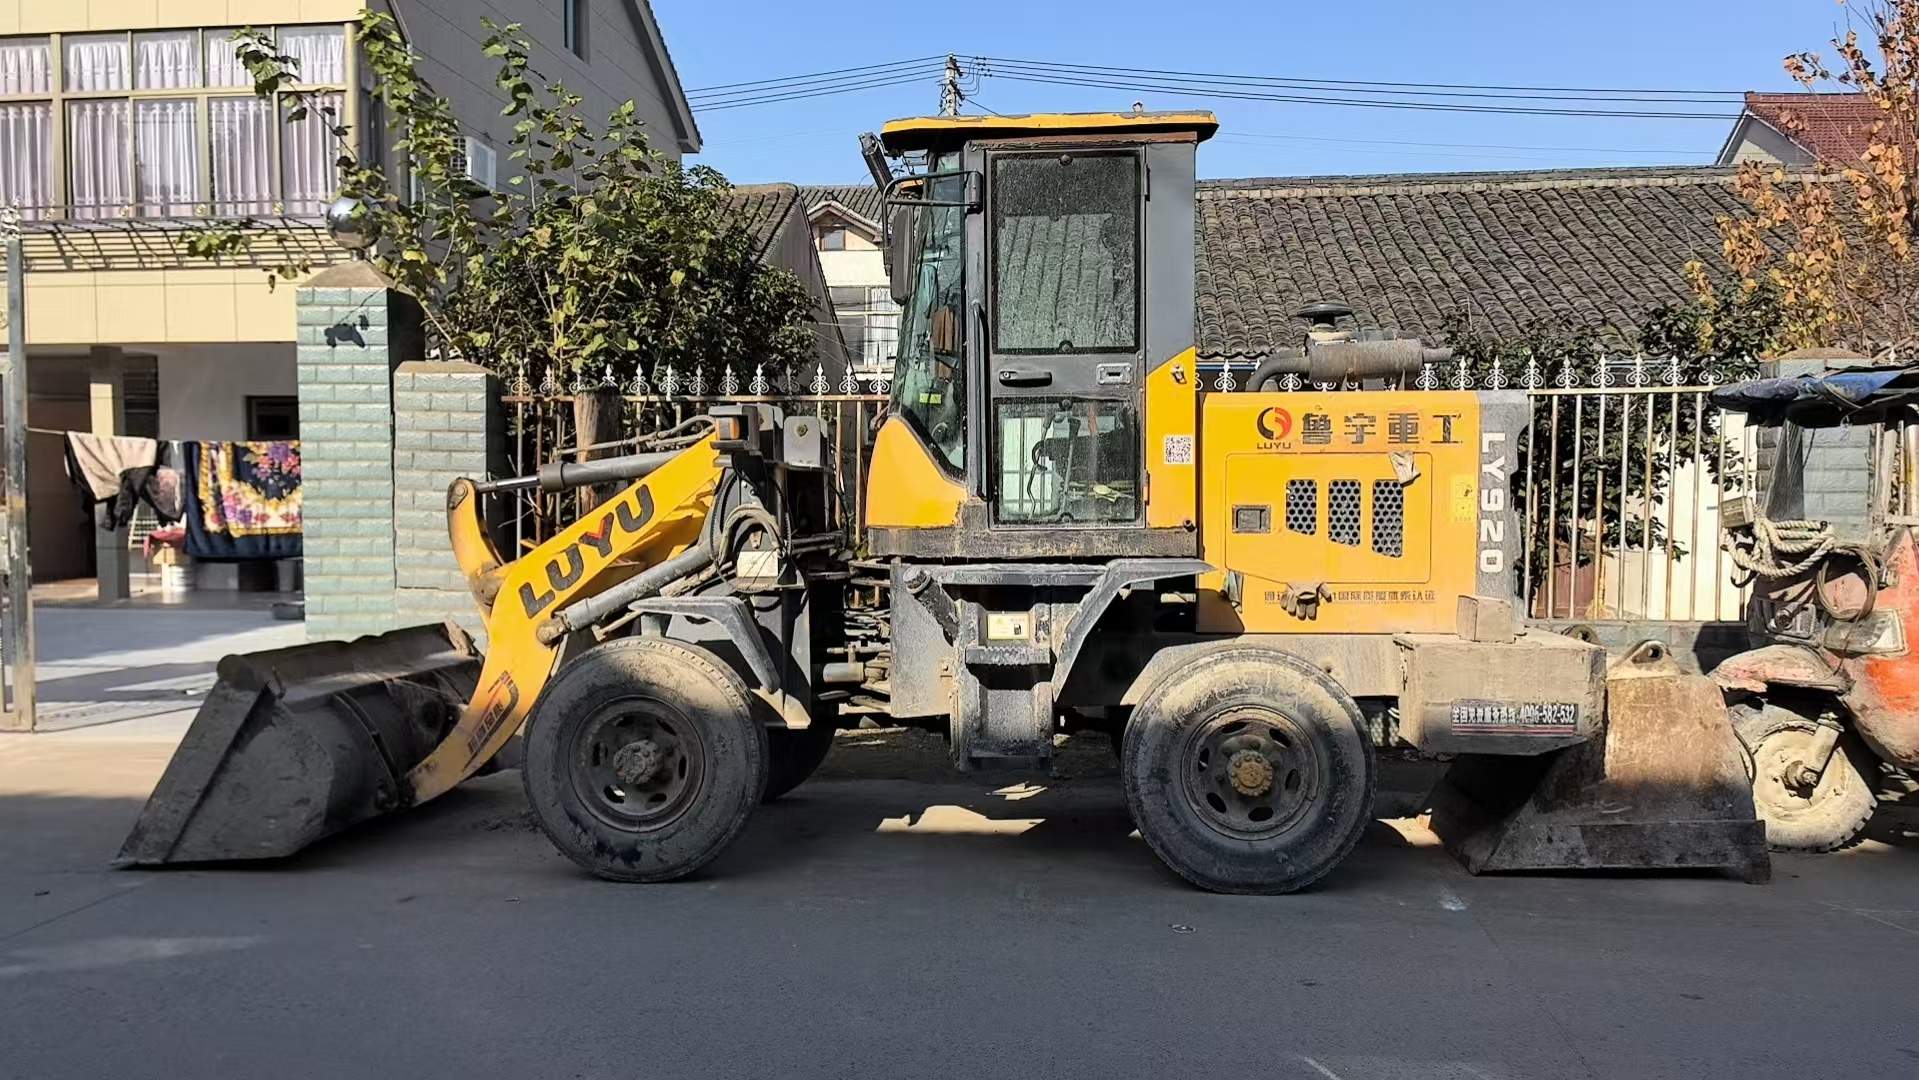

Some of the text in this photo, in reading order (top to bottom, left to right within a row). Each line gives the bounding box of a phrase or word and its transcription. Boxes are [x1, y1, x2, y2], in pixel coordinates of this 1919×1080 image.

[1301, 412, 1461, 444] 鲁宇重工
[518, 484, 655, 619] LUYU
[1480, 432, 1506, 573] LY920
